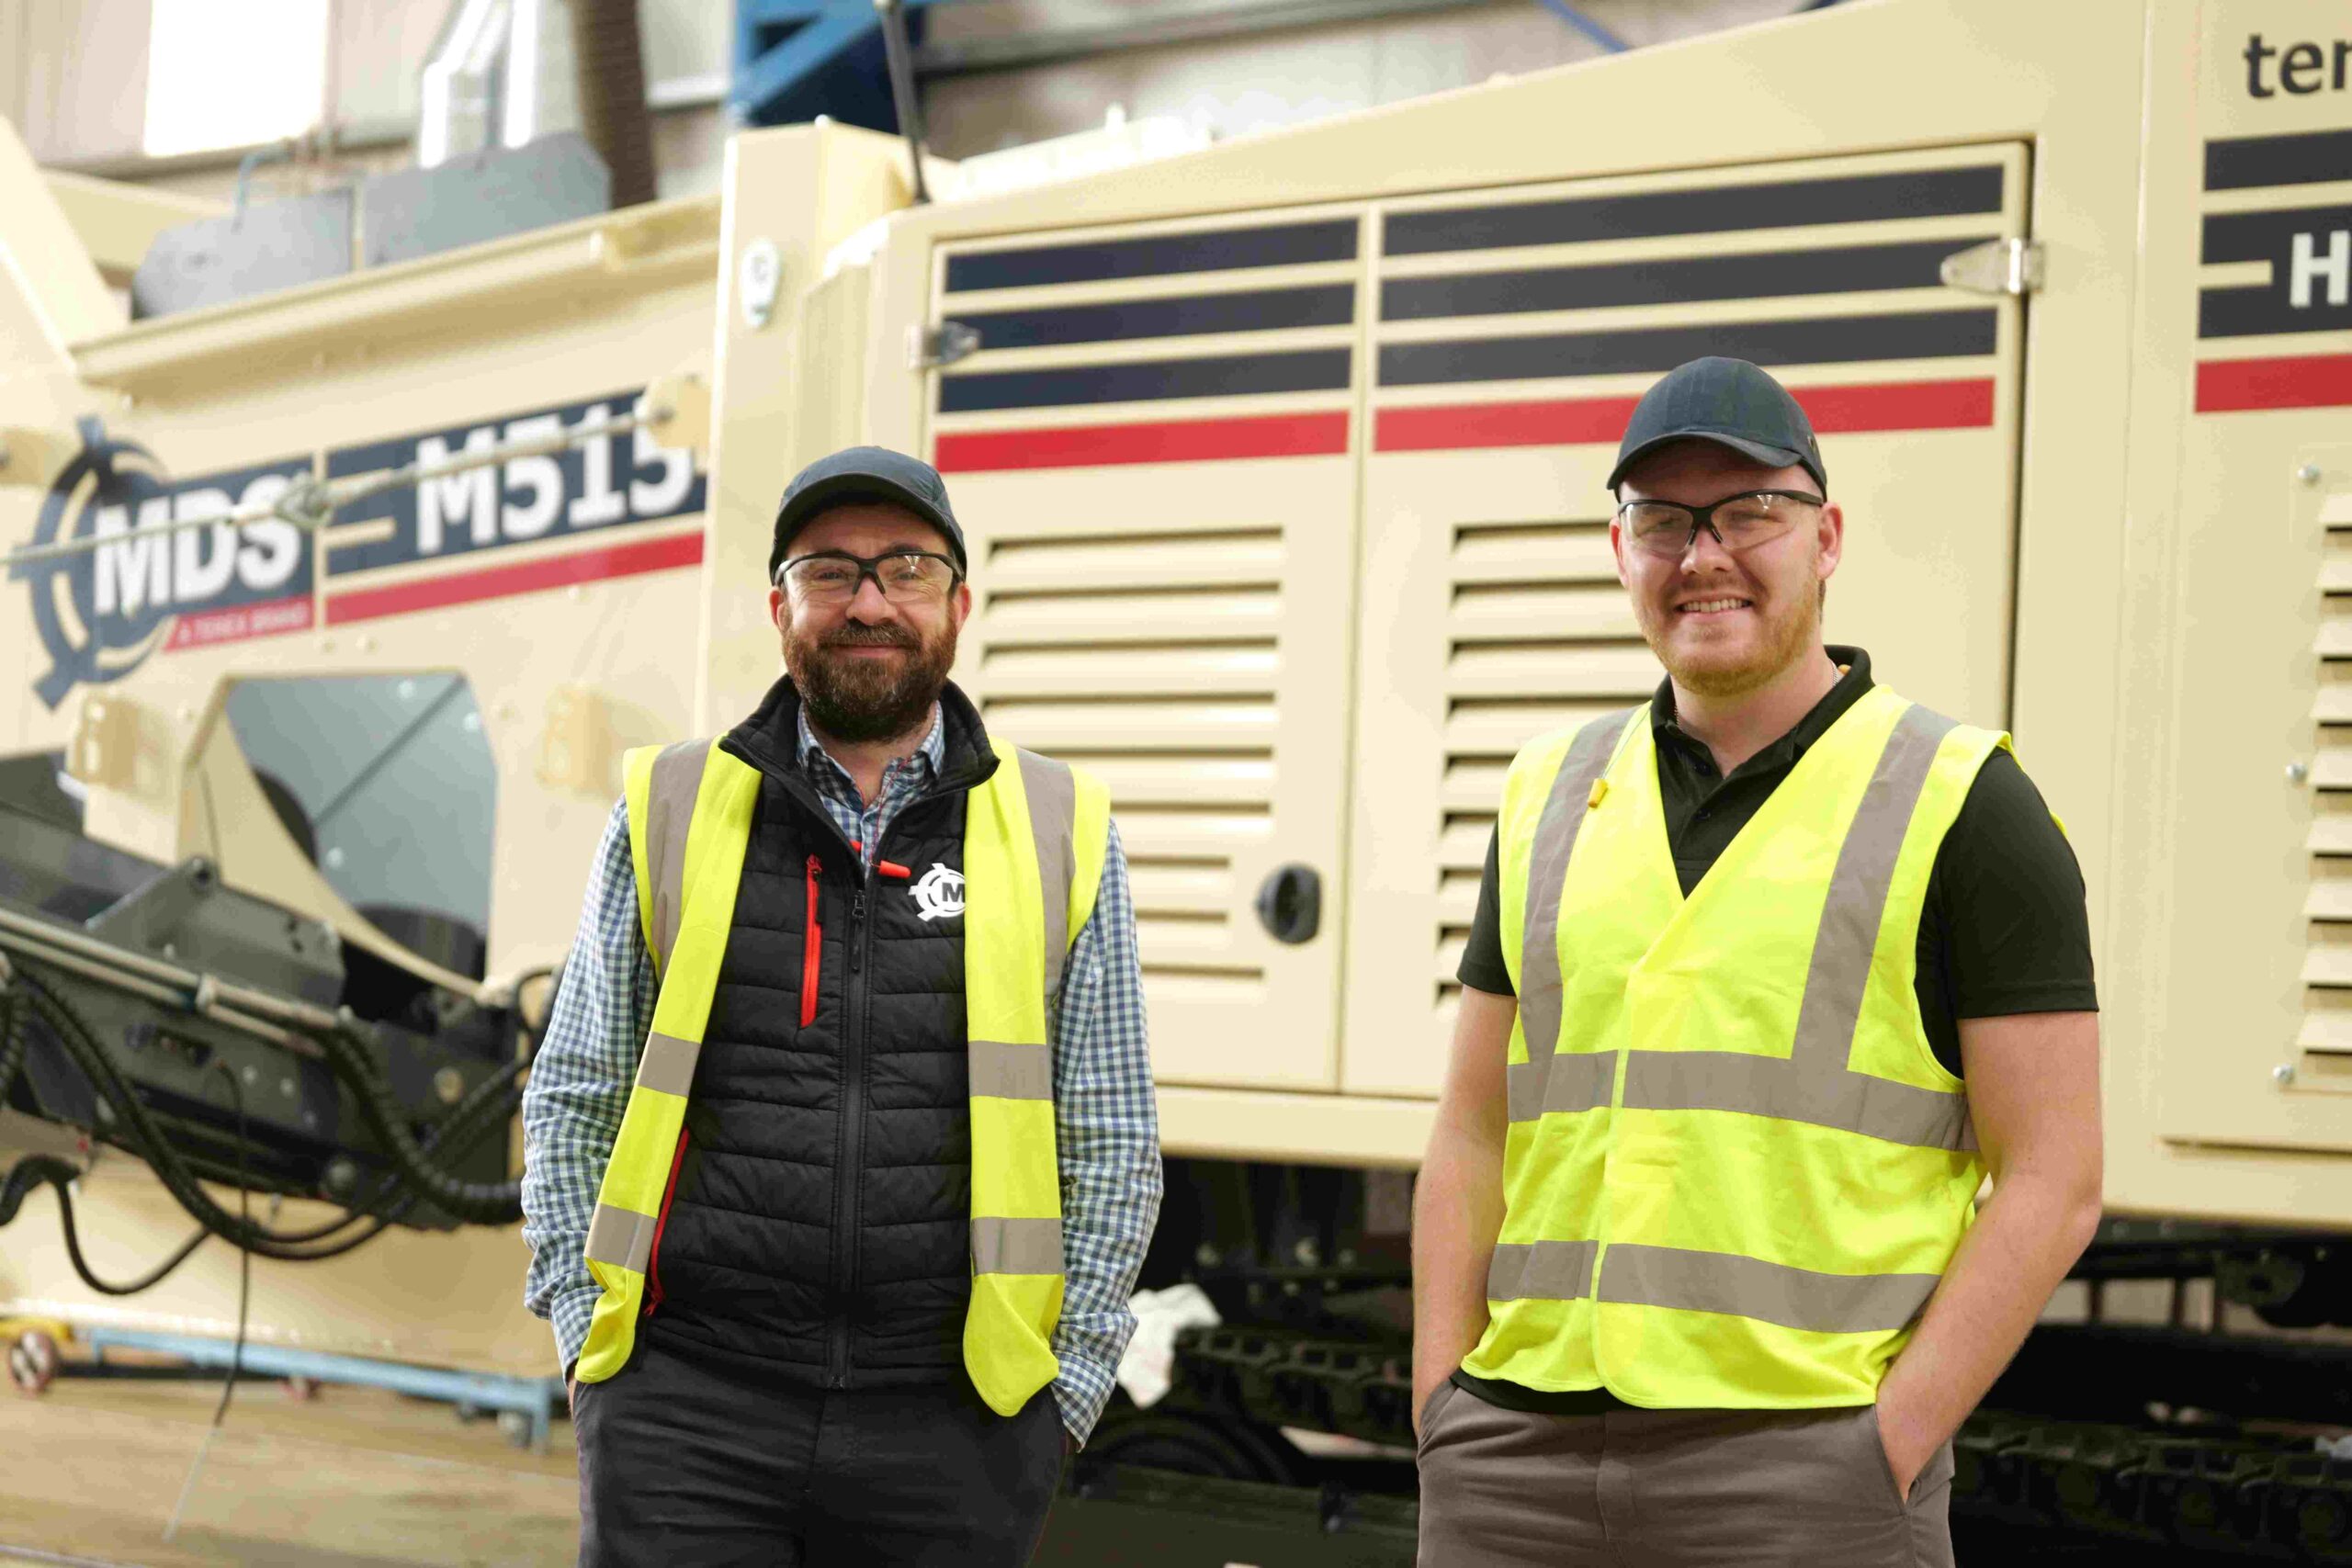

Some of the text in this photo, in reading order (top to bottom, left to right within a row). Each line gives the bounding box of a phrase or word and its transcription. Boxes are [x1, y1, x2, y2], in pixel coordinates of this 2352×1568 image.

[94, 474, 301, 617] MDS
[416, 398, 693, 555] M515
[942, 882, 965, 903] M
